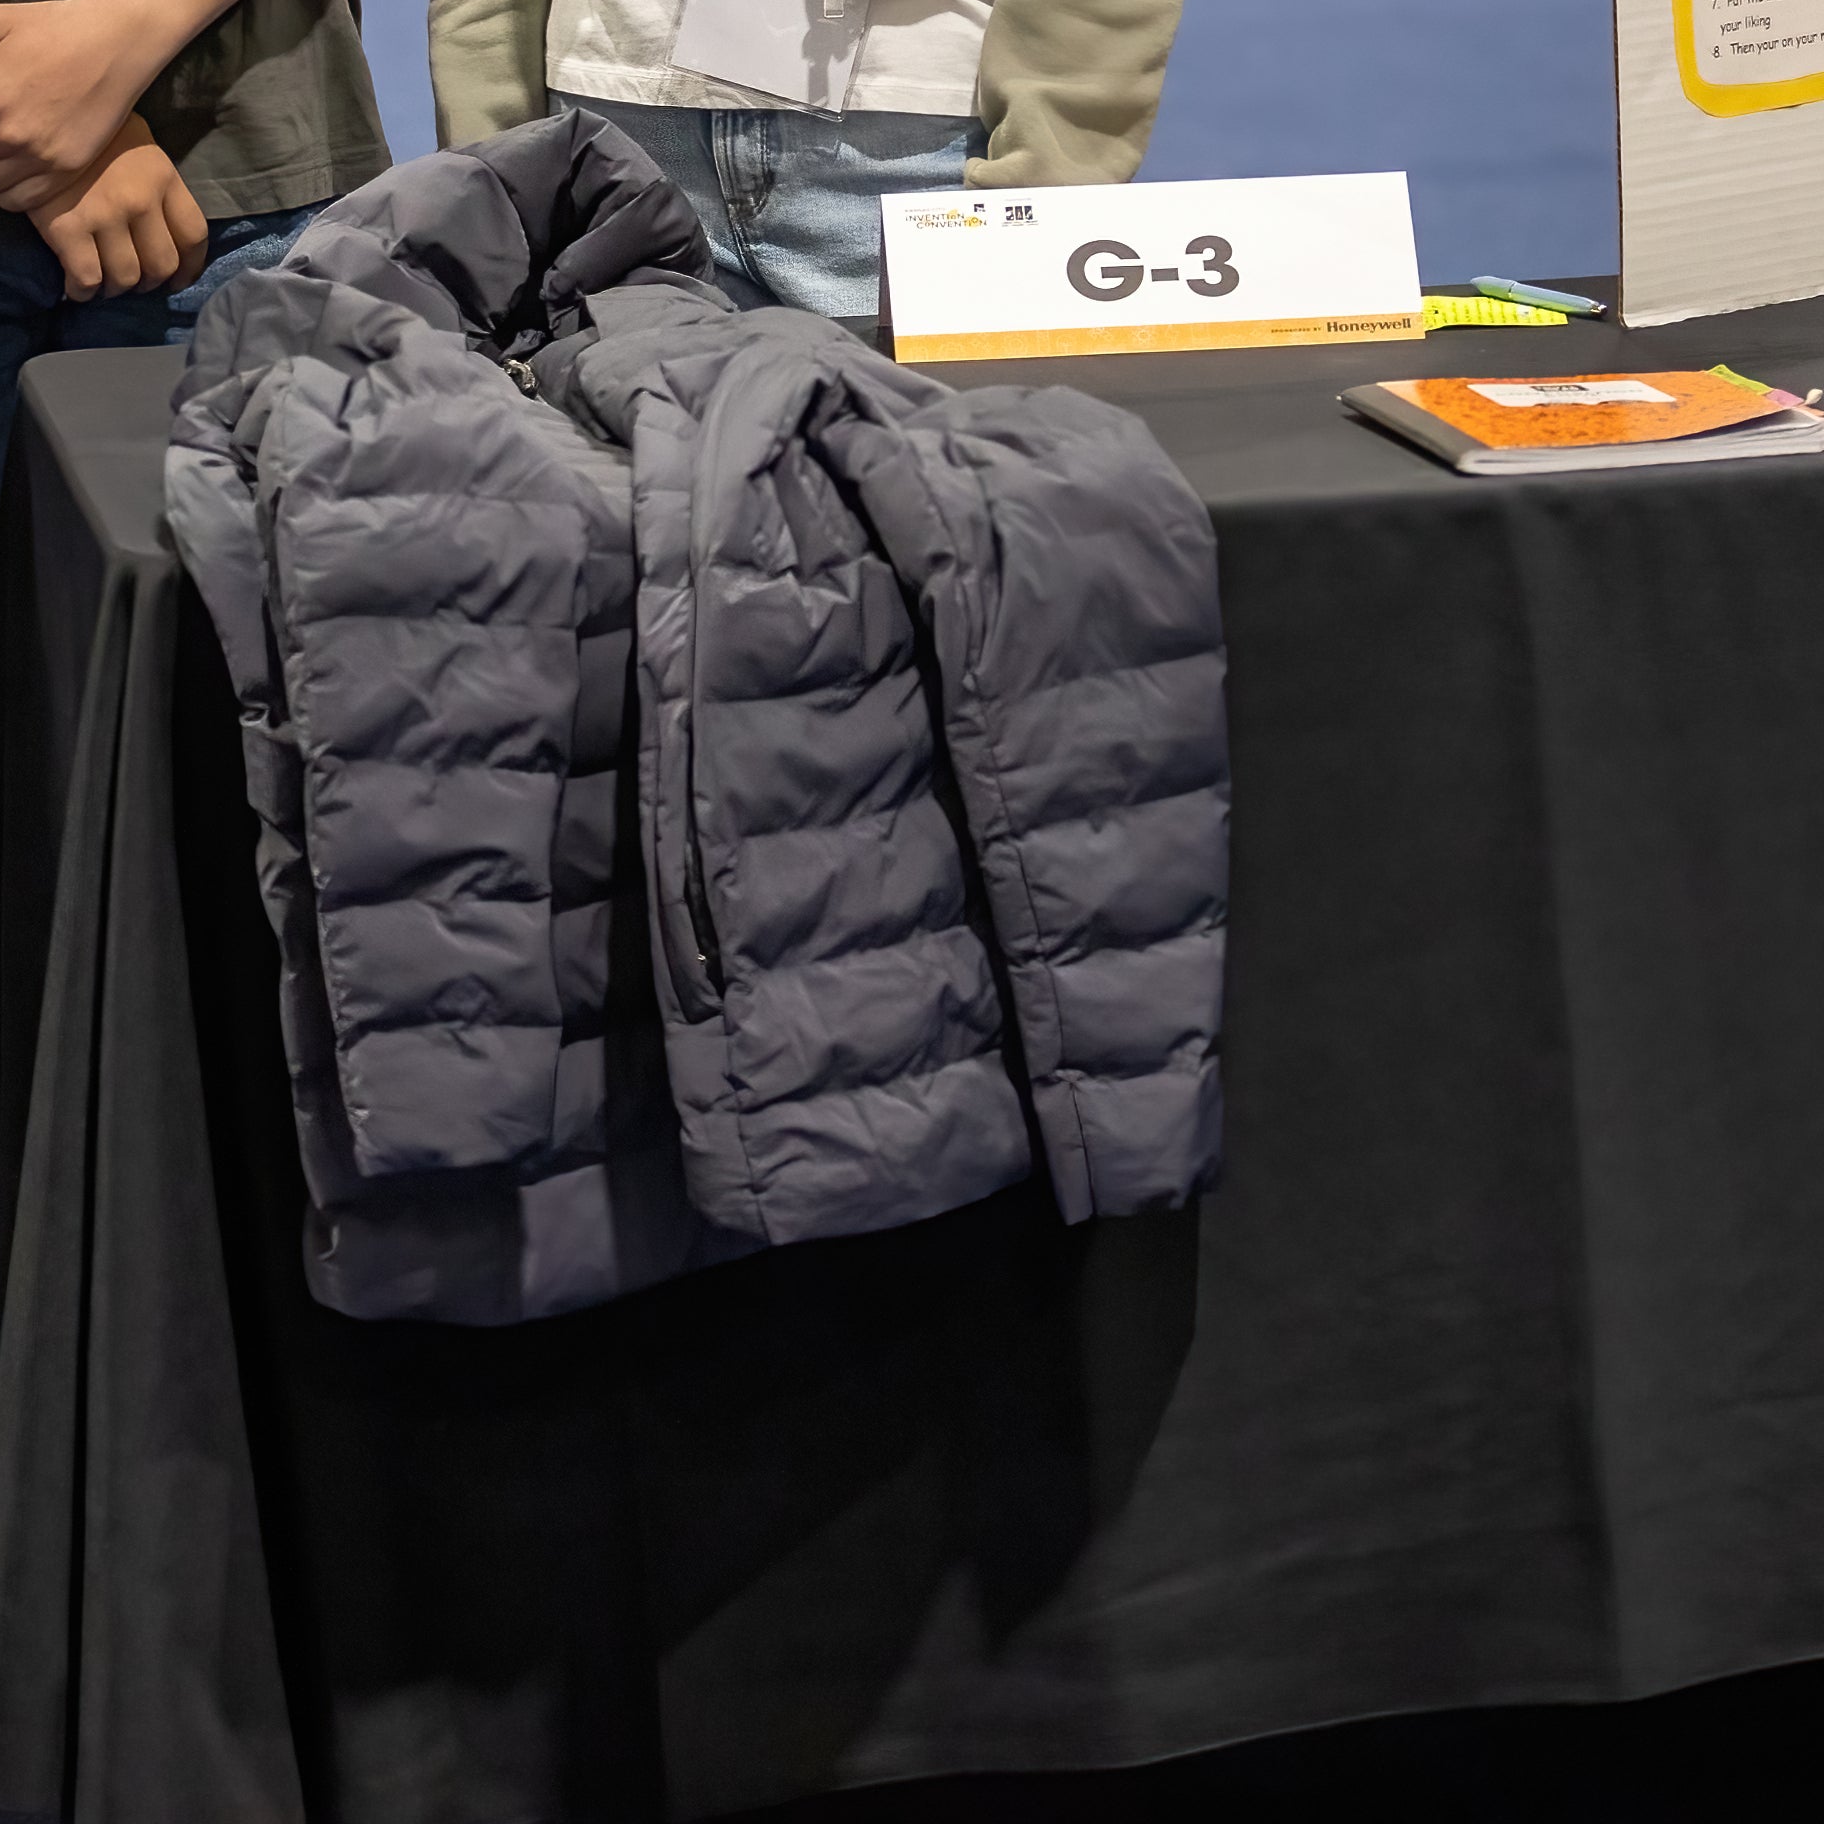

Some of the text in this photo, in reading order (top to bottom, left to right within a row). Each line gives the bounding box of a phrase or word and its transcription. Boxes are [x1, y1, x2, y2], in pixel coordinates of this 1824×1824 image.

[1729, 41, 1755, 54] Then
[1755, 39, 1779, 55] your
[1781, 37, 1793, 47] on
[1795, 33, 1817, 48] your
[905, 212, 965, 222] INVENTION
[916, 217, 987, 229] CONVENTION
[1066, 235, 1240, 302] G-3
[1327, 318, 1412, 334] Honeywell
